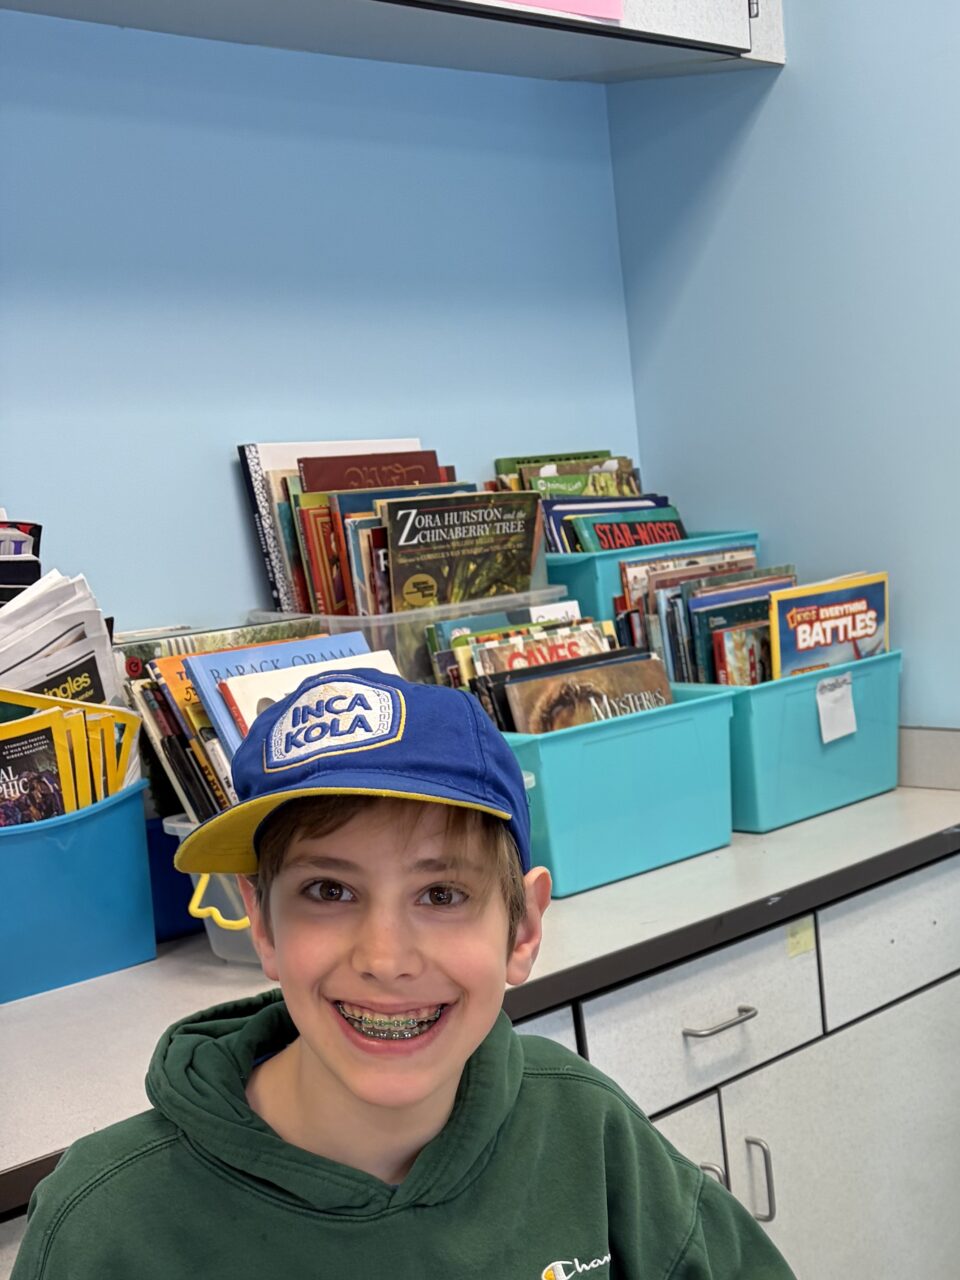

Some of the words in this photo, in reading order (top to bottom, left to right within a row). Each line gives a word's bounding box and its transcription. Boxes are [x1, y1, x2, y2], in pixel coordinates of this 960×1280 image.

[396, 508, 441, 546] ZORA
[444, 508, 502, 525] HURSTON
[516, 511, 526, 519] the
[417, 523, 492, 543] CHINABERRY
[494, 520, 525, 534] TREE
[593, 522, 682, 550] STAR-NOSED
[796, 609, 878, 650] BATTLES
[507, 640, 581, 671] CAVES
[292, 693, 373, 728] INCA
[589, 690, 666, 722] MYSTERIES
[284, 714, 374, 754] KOLA
